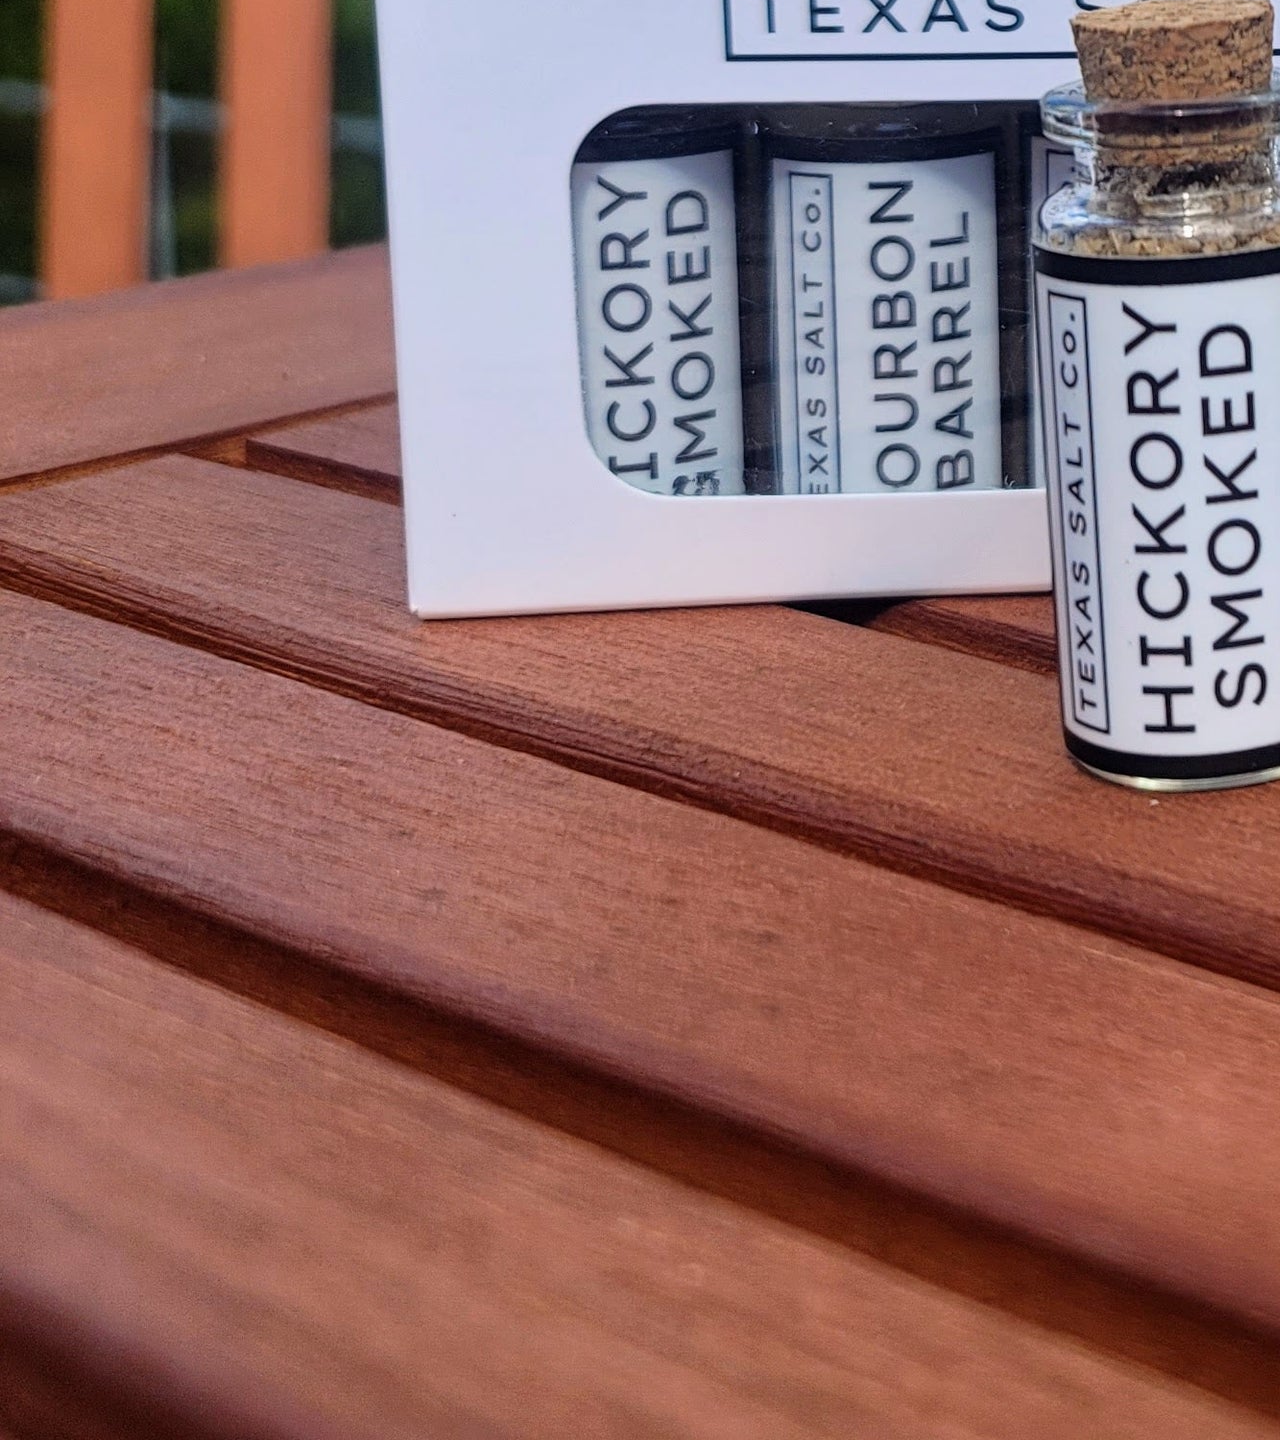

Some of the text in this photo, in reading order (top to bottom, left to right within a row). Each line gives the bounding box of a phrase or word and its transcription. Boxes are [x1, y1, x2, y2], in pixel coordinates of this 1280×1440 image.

[802, 187, 822, 252] Co.
[803, 273, 827, 377] SALT
[929, 211, 975, 489] BARREL
[1060, 311, 1099, 712] TEXAS SALT Co.
[1121, 301, 1196, 735] HICKORY
[1199, 322, 1268, 707] SMOKED
